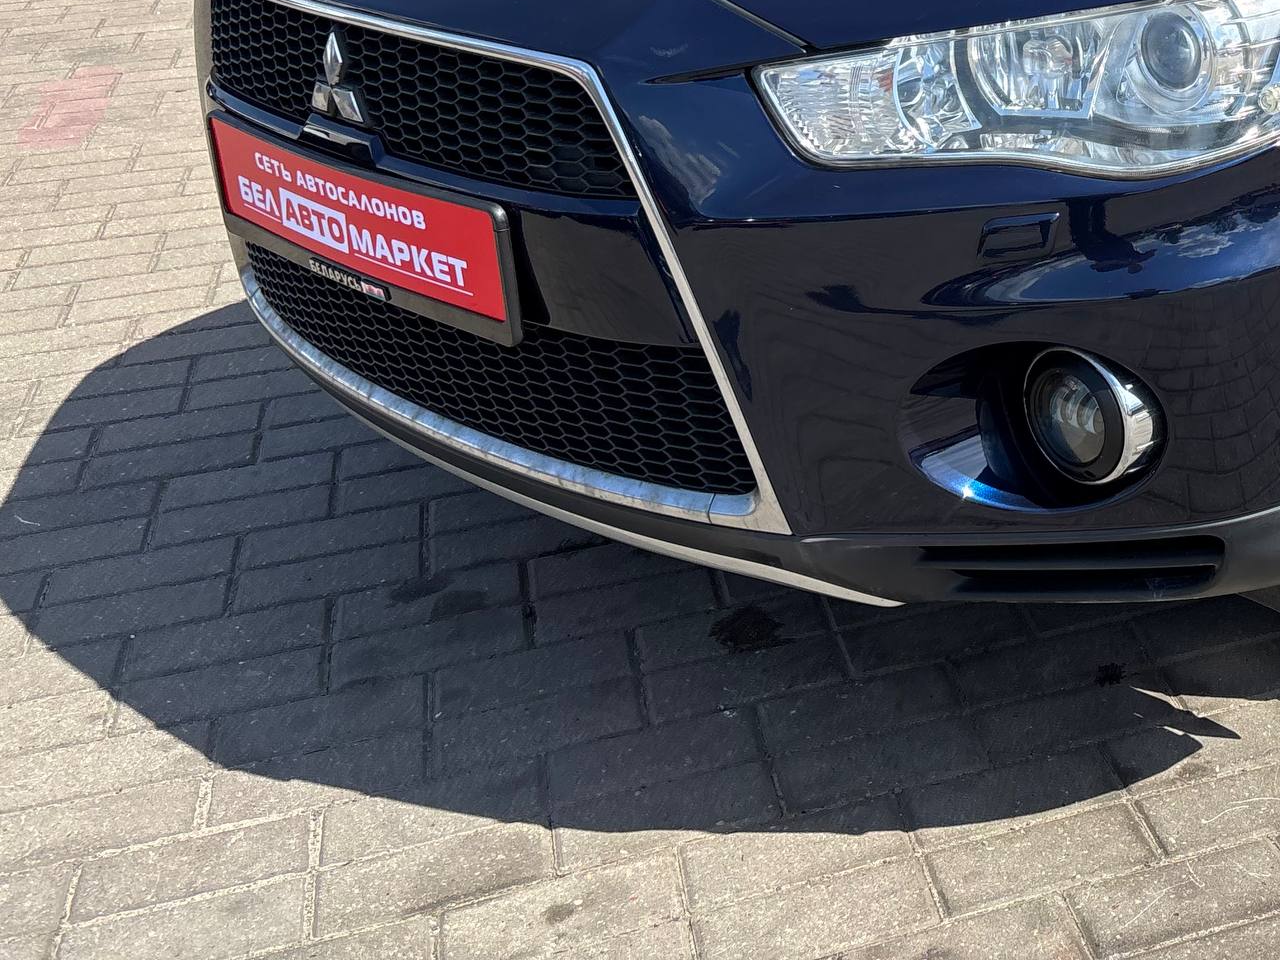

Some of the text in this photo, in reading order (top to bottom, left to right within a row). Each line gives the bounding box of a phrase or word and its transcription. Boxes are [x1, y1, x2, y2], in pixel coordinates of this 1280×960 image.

[254, 151, 426, 230] СЕТЬ АВТОСАЛОНОВ
[309, 259, 361, 292] БЕЛАРУСЬ
